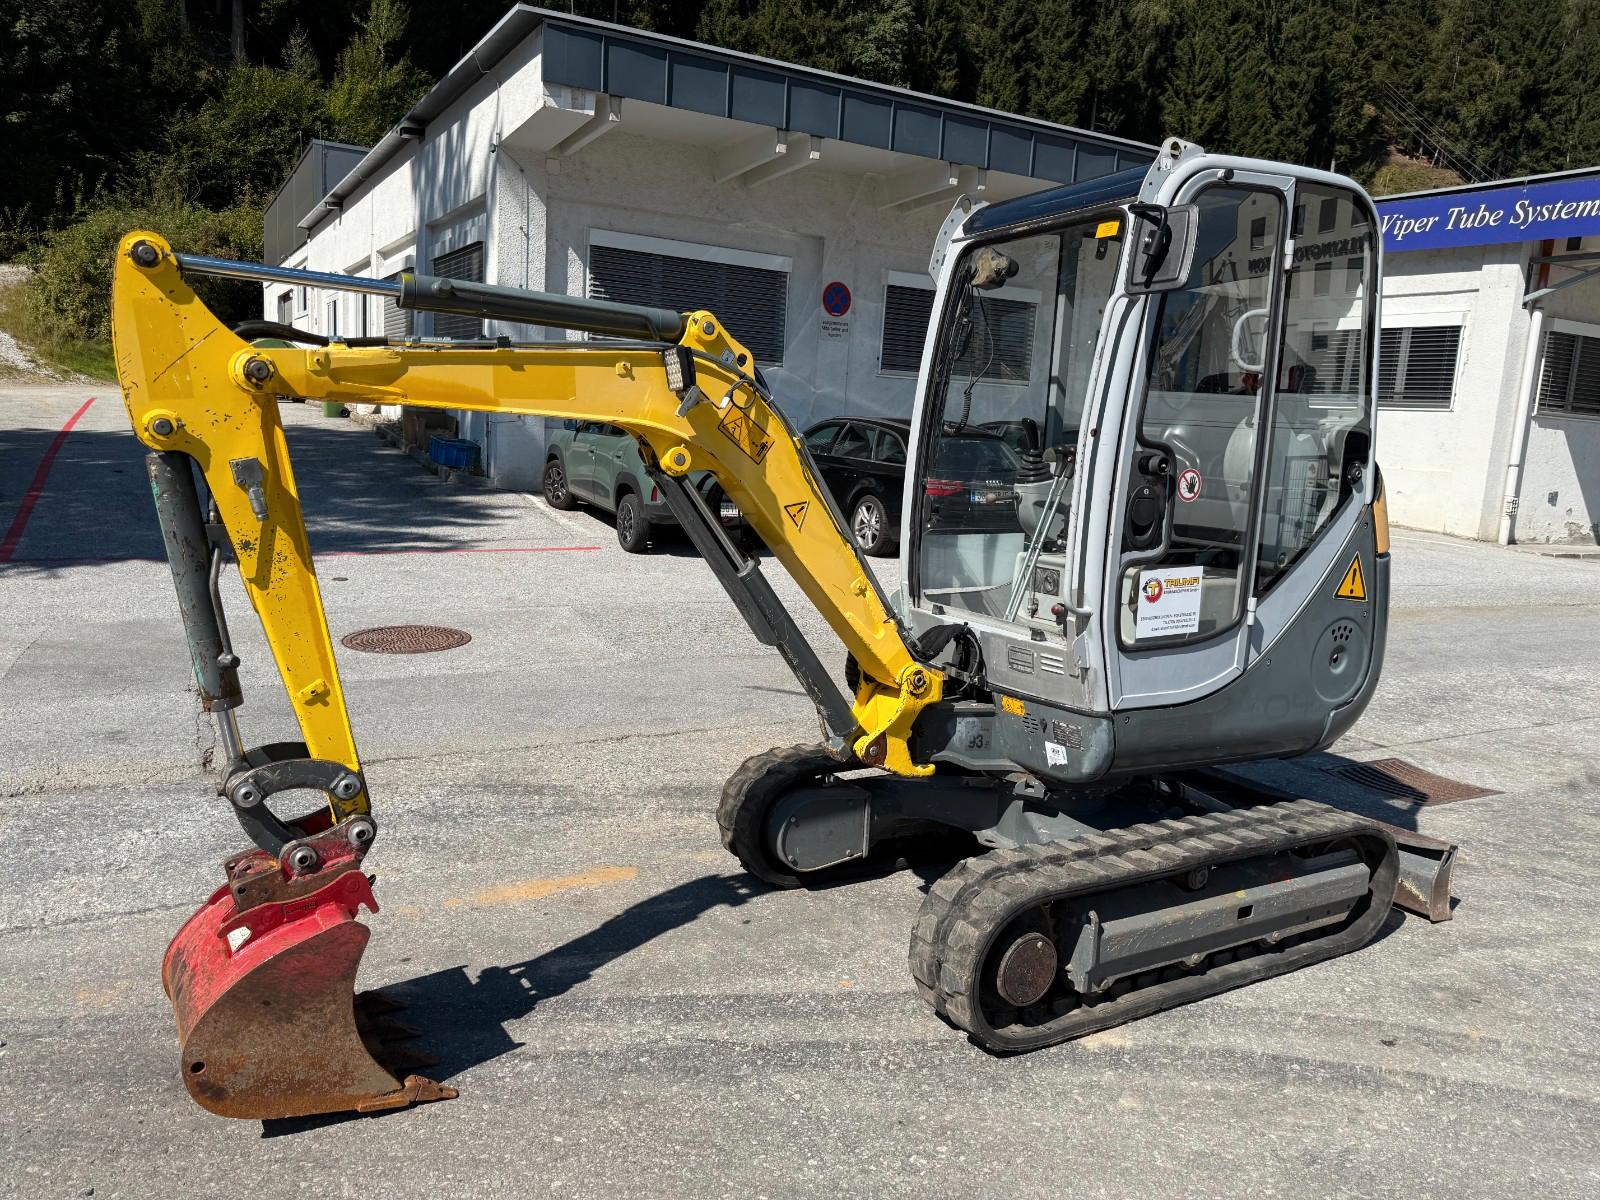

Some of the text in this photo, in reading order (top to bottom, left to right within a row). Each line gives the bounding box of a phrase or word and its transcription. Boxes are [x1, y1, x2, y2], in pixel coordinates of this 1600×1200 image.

[1382, 199, 1600, 241] Viper Tube System
[968, 734, 984, 749] 93
